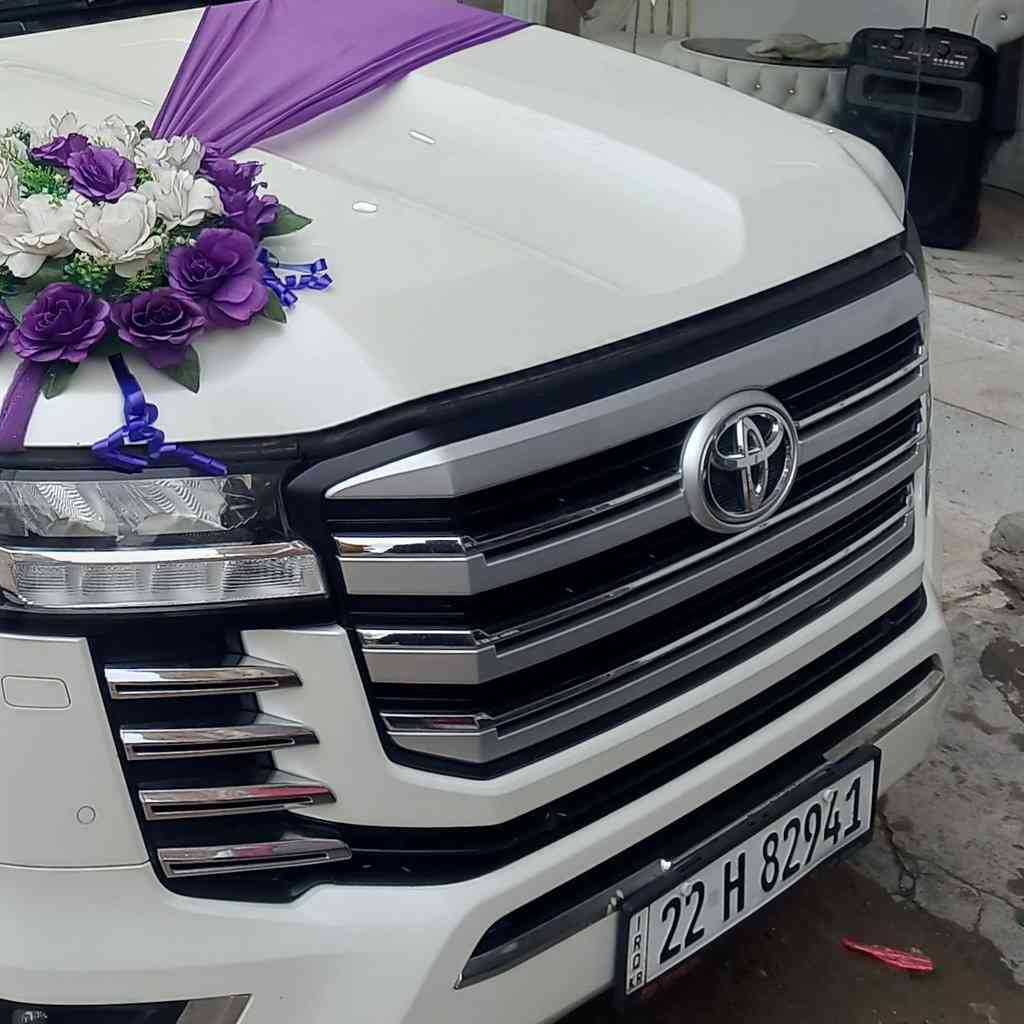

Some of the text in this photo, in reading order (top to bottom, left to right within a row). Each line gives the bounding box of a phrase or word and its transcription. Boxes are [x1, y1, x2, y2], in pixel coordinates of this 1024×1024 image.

[659, 777, 864, 964] 22 H 82941
